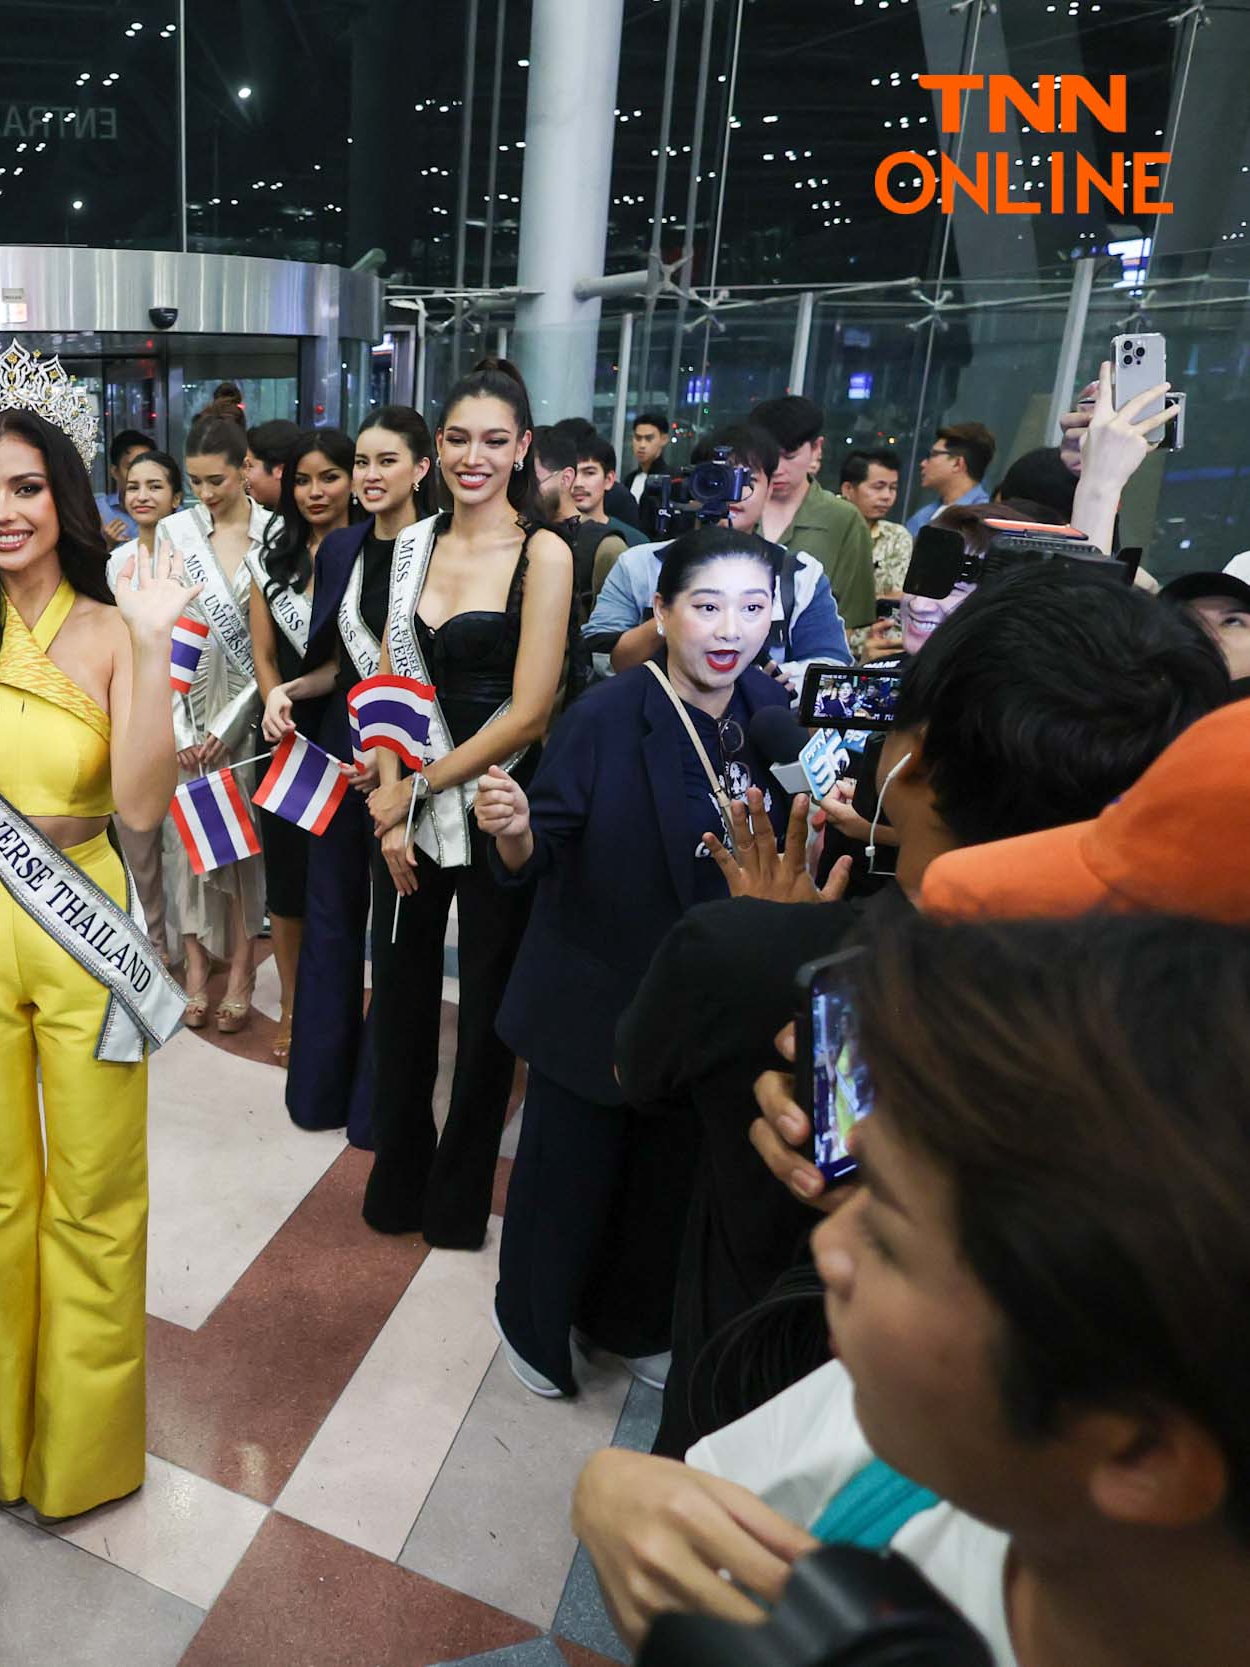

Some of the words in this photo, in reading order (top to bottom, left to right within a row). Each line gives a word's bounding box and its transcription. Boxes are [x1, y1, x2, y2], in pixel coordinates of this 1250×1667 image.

[396, 538, 416, 583] MISS
[184, 554, 209, 584] MISS
[204, 594, 248, 659] UNIVERSE
[275, 594, 304, 632] MISS
[390, 598, 413, 678] UNIVERS
[402, 630, 420, 673] RUNNER
[46, 881, 152, 993] THAILAND
